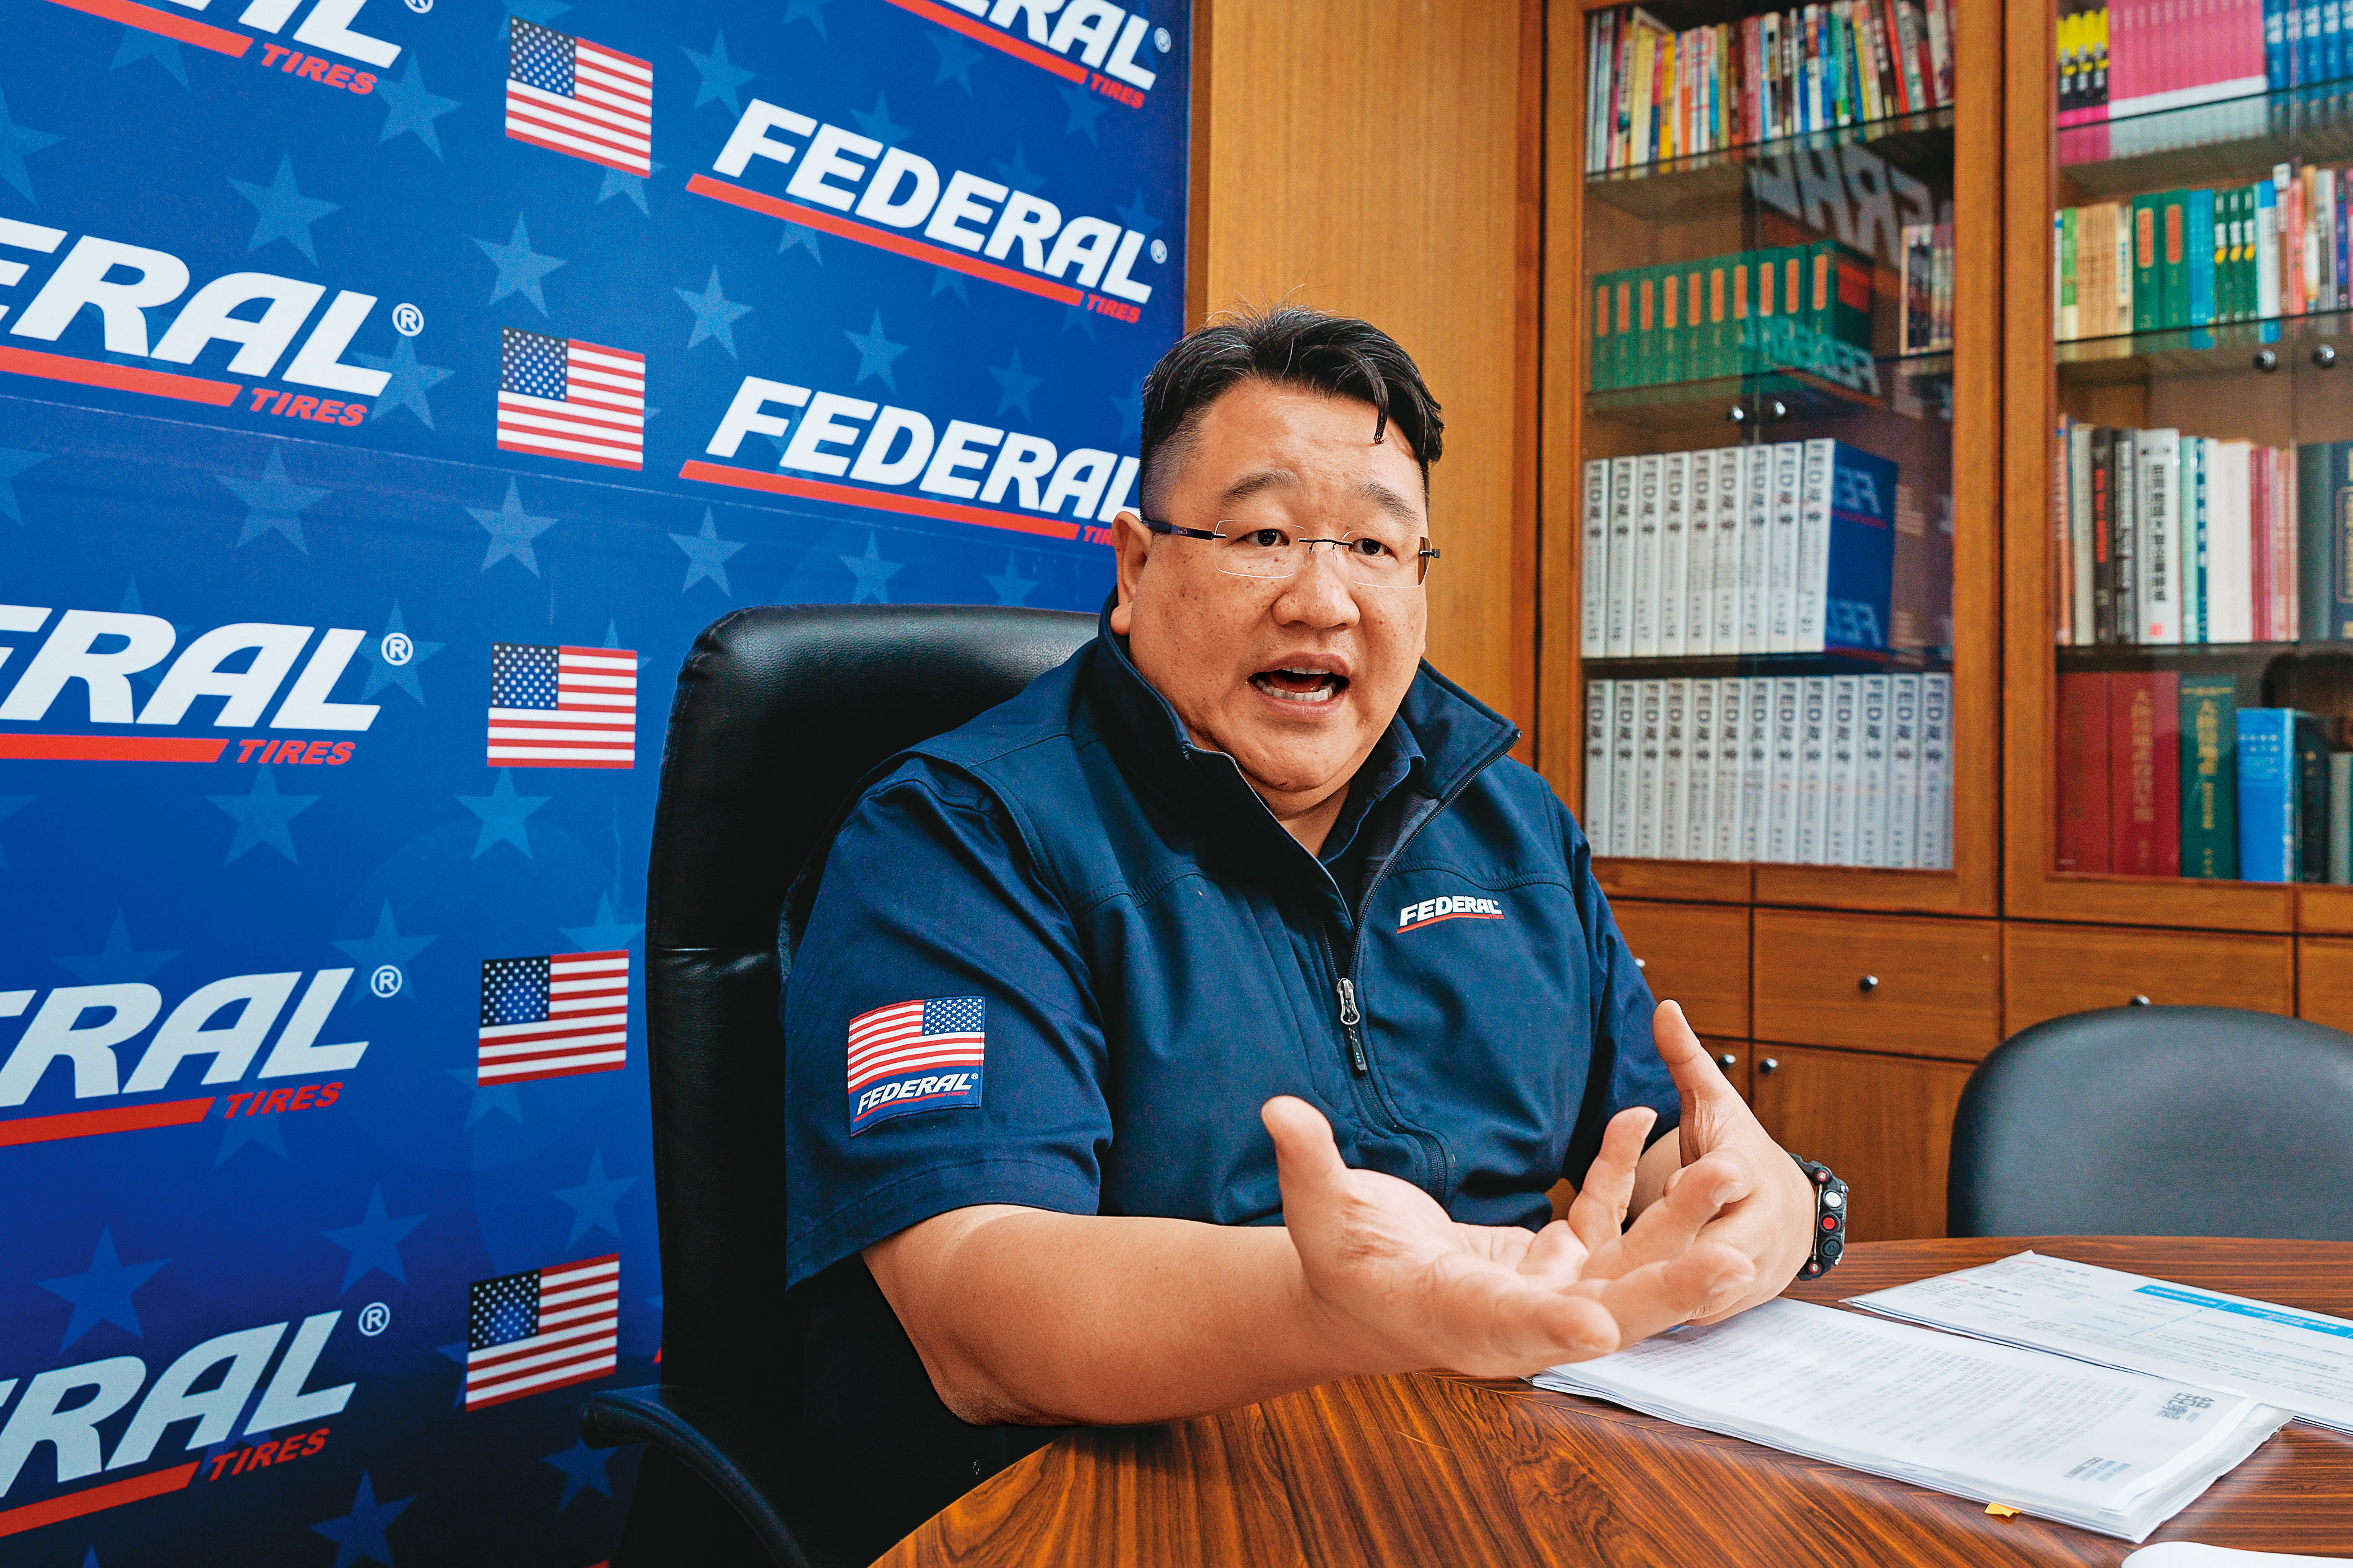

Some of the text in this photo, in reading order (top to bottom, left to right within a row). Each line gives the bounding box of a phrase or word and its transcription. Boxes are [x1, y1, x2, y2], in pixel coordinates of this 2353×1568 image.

[262, 43, 378, 95] TIRES
[1091, 73, 1145, 109] TIRES
[713, 98, 1152, 304] FEDERAL
[0, 217, 393, 397] RAL
[1087, 293, 1142, 324] TIRES
[251, 388, 367, 427] TIRES
[705, 375, 1141, 524] FEDERAL
[1083, 523, 1115, 547] TIR
[0, 604, 381, 732] RAL
[237, 739, 356, 765] TIRES
[1399, 895, 1502, 927] FEDERAL
[0, 967, 370, 1107] RAL
[224, 1081, 344, 1119] TIRES
[856, 1073, 972, 1115] FEDERAL
[0, 1309, 357, 1498] RAL
[209, 1427, 331, 1481] TIRES
